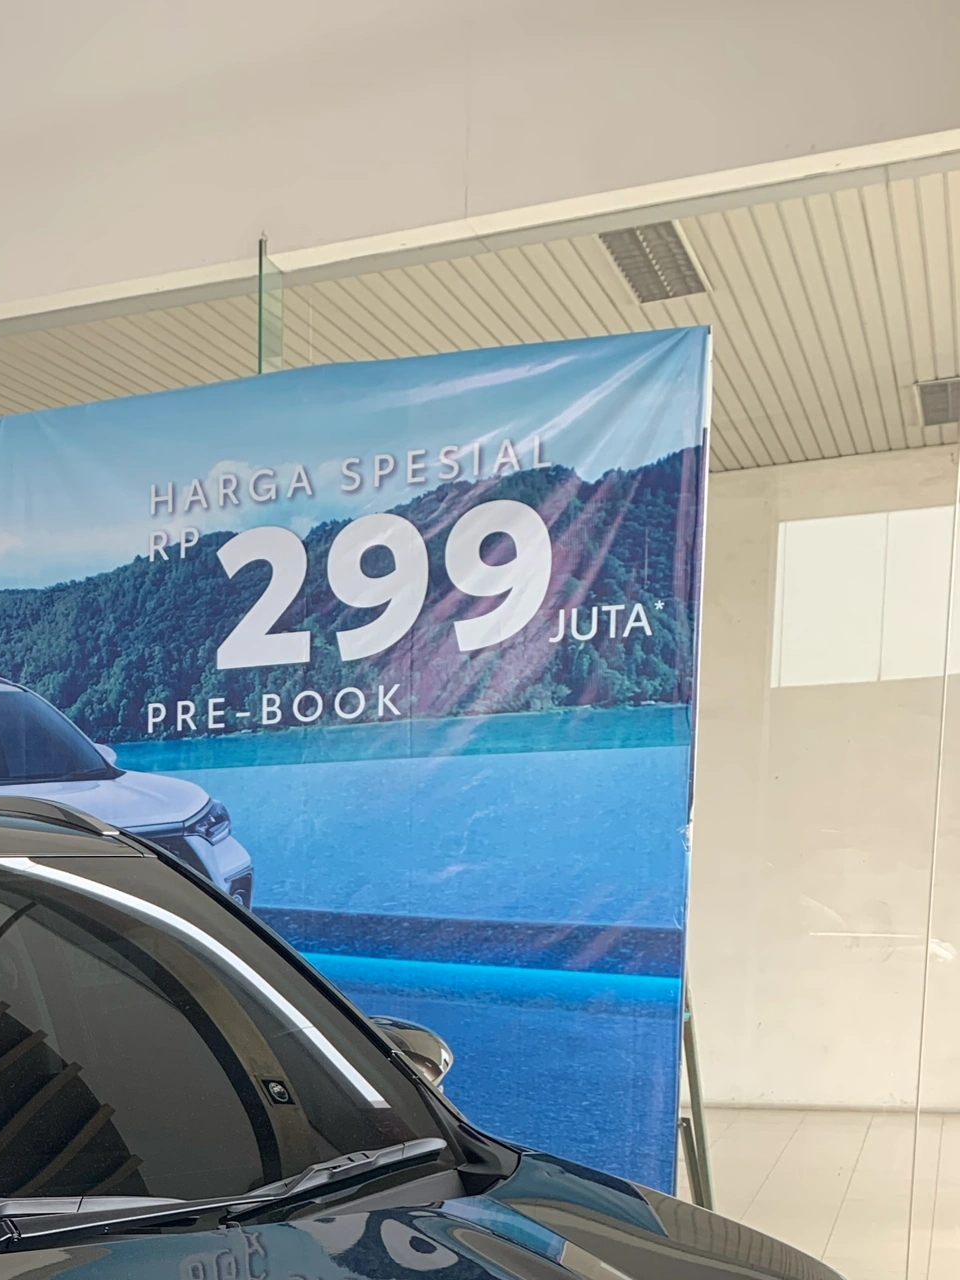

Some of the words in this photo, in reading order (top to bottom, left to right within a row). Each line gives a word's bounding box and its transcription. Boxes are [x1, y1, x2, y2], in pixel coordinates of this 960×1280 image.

[149, 464, 314, 516] HARGA
[340, 438, 553, 492] SPESIAL
[148, 527, 200, 563] RP
[216, 499, 553, 671] 299
[147, 683, 403, 734] PRE-BOOK
